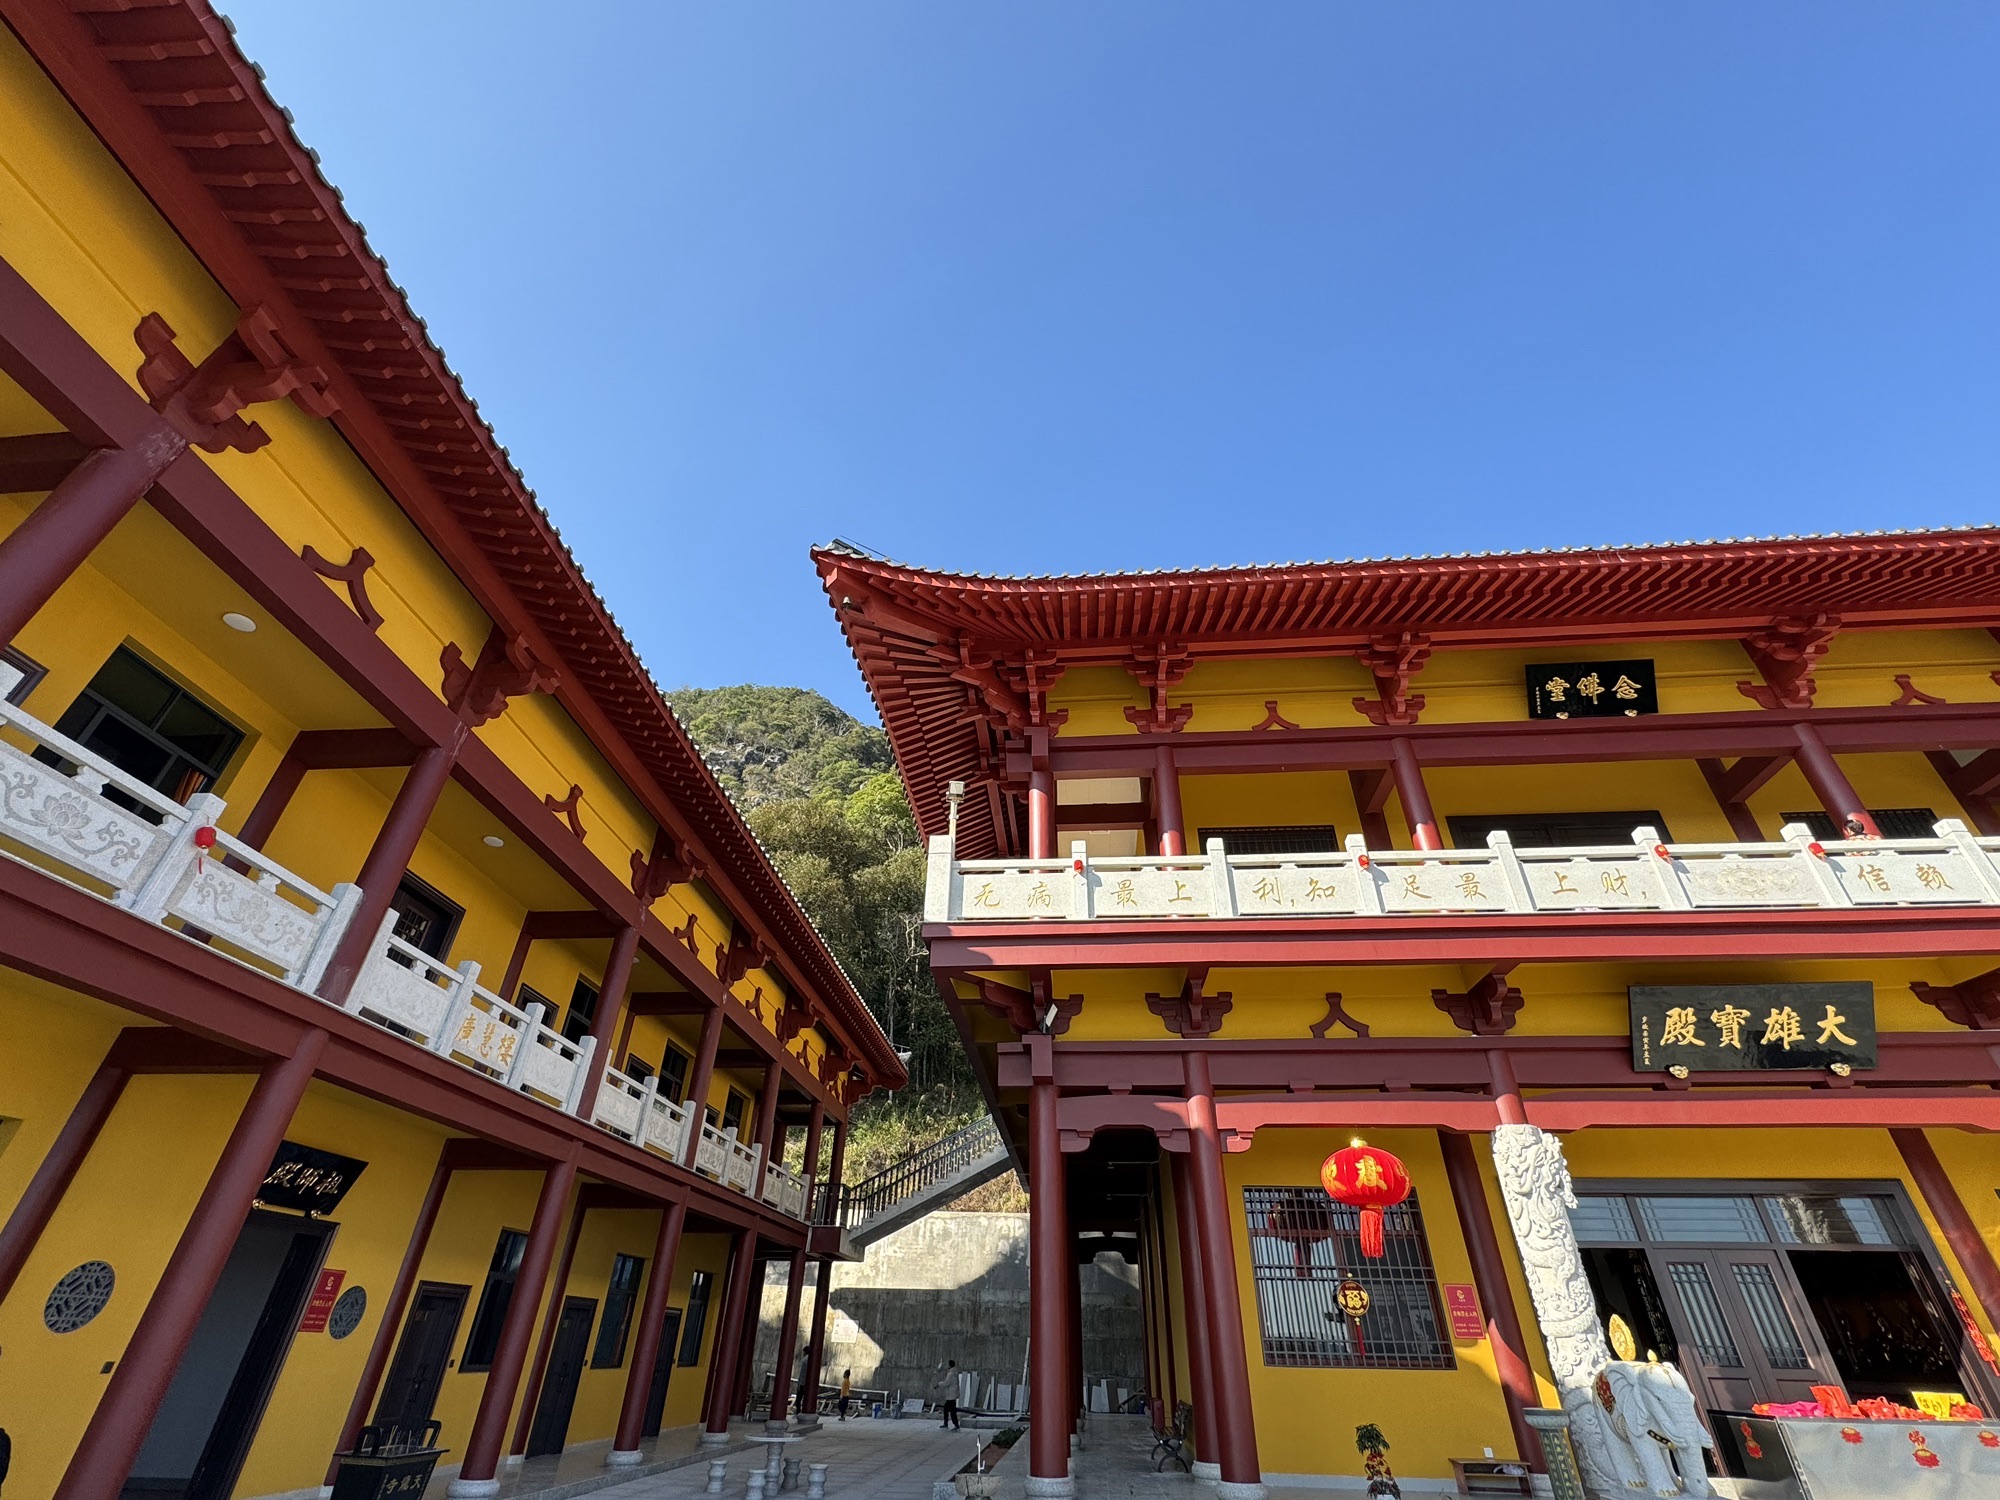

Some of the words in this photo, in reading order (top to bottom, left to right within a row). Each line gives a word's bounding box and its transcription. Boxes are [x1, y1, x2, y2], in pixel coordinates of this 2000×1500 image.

[1545, 672, 1642, 704] 念佛堂
[1660, 1003, 1858, 1051] 大雄寶殿
